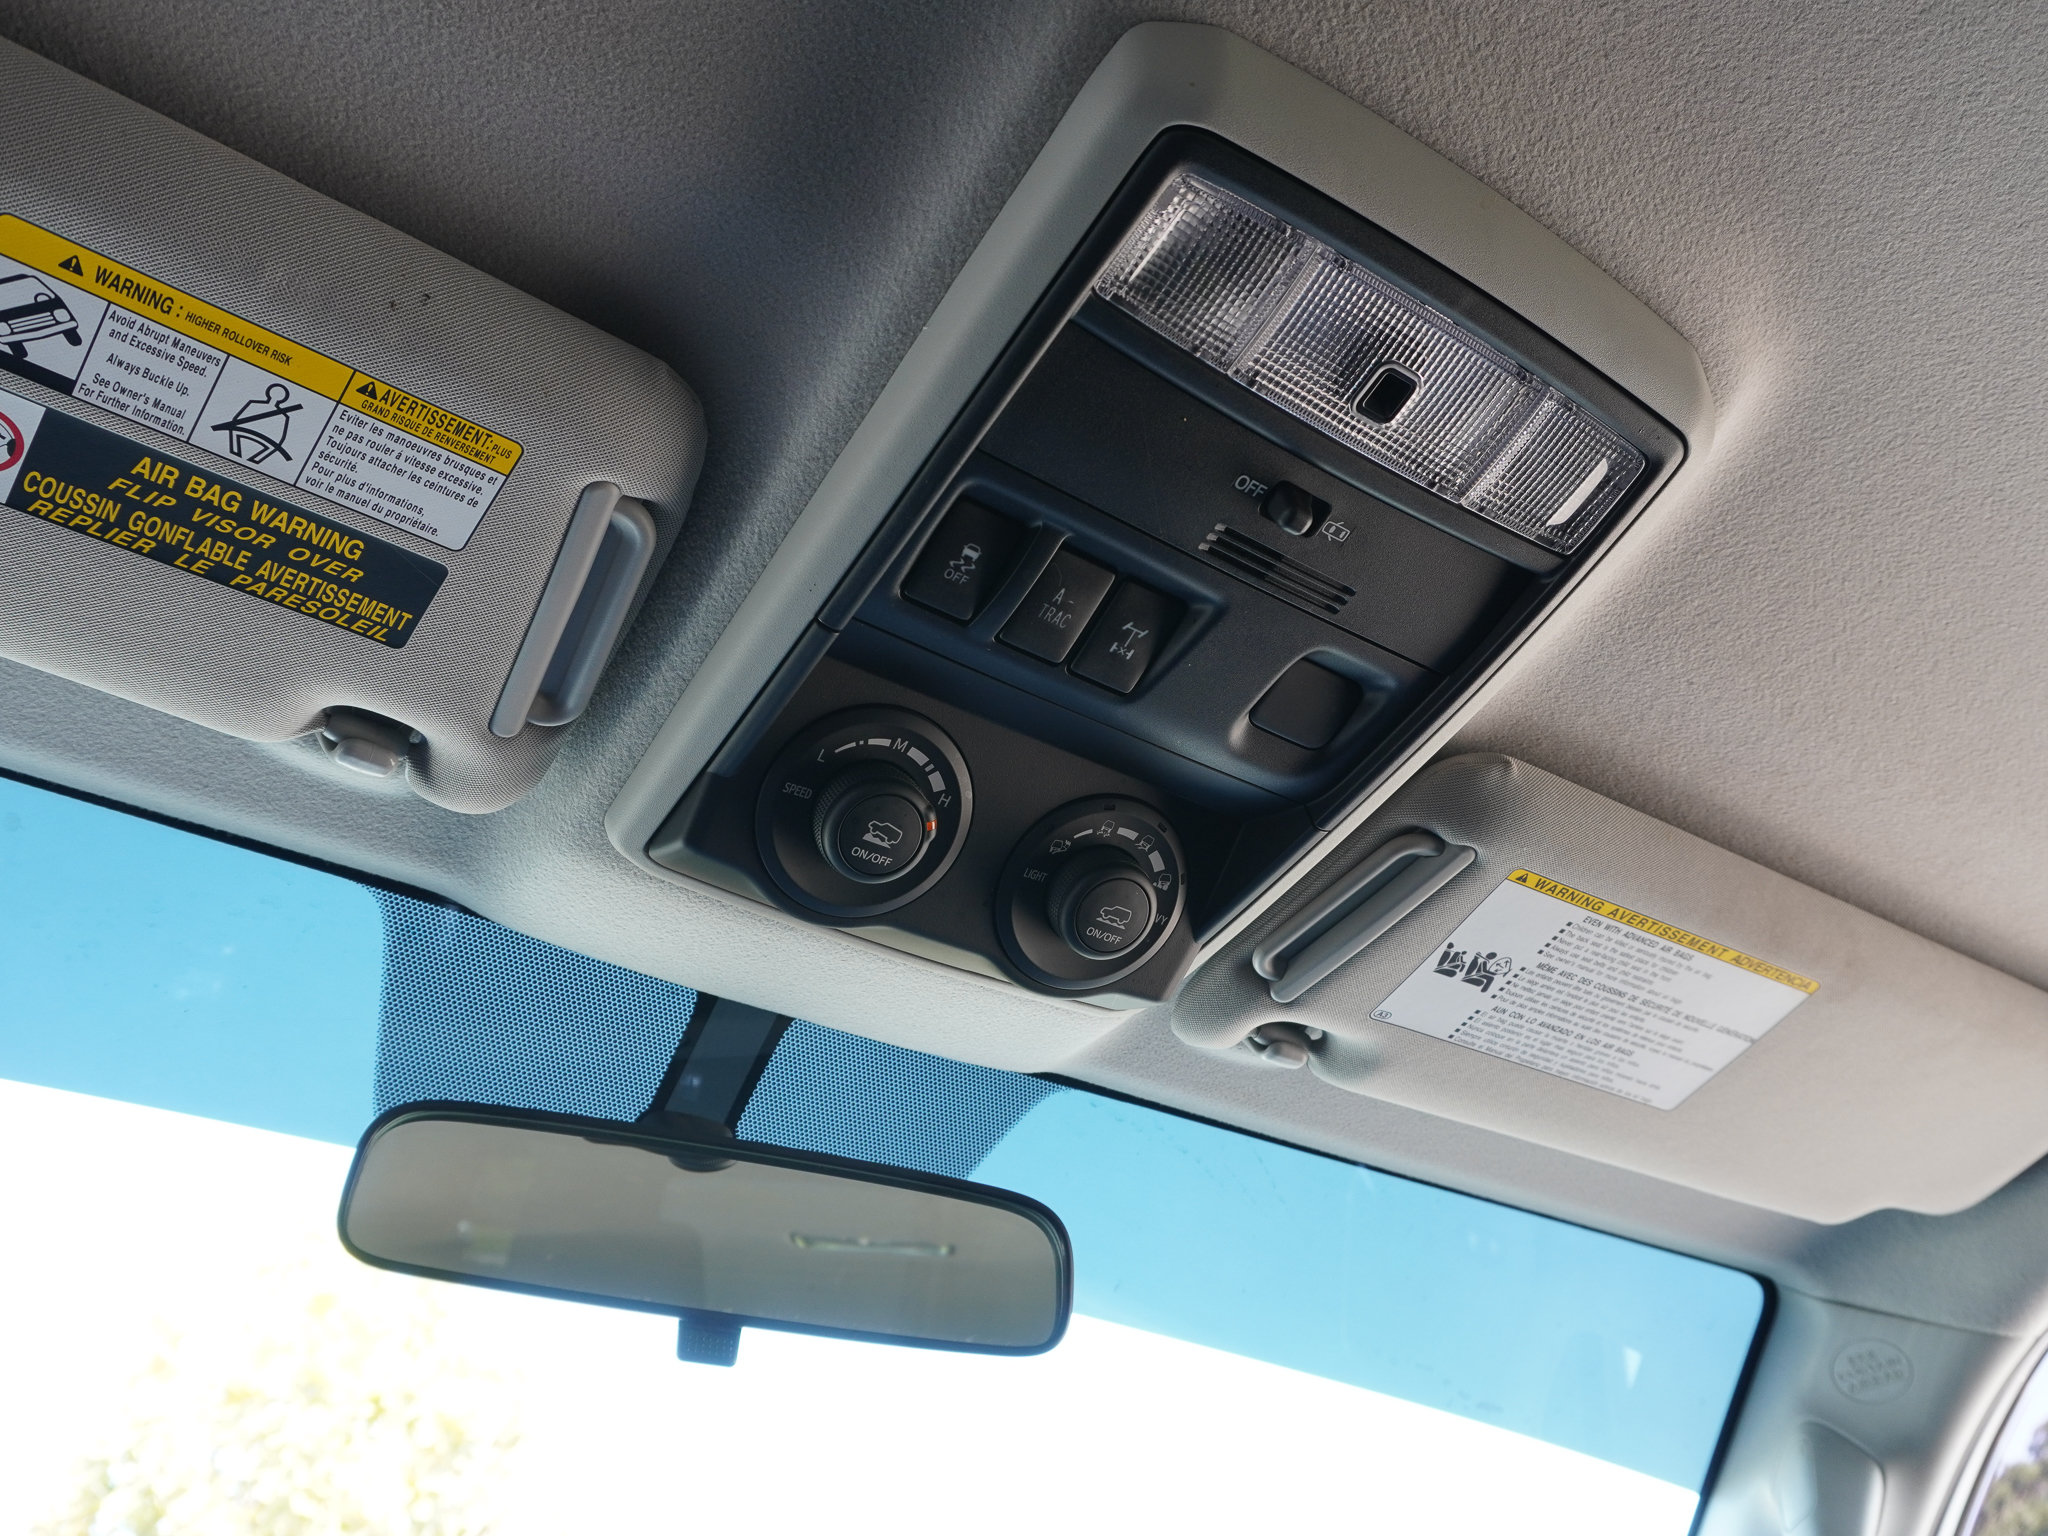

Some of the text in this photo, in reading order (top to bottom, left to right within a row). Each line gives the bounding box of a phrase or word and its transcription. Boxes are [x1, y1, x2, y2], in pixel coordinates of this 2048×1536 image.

[108, 310, 221, 367] Avoid Abrupt Maneuvers
[109, 328, 207, 378] and Excessive Speed.
[185, 311, 221, 334] HIGHER
[222, 328, 270, 356] ROLLOVER
[270, 349, 293, 366] RISK
[93, 373, 186, 420] See Owner's Manual
[106, 353, 189, 396] Always Buckle Up.
[78, 383, 185, 436] For Further Information.
[361, 400, 496, 465] GRAND RISQUE DE RENVERSEMENT
[379, 389, 513, 459] AVERTISSEMENT: PLUS
[318, 450, 358, 474] sécurité.
[332, 425, 344, 436] ne
[345, 432, 365, 446] pas
[367, 437, 395, 456] rouler
[404, 454, 436, 476] vitesse
[437, 470, 483, 496] excessive.
[339, 410, 498, 486] Eviter les manoeuvres brusques et
[311, 461, 425, 517] Pour plus d'informations,
[325, 436, 479, 509] Toujours attacher les ceintures de
[1235, 475, 1269, 496] OFF
[130, 456, 365, 561] AIR BAG WARNING
[305, 474, 439, 537] voir le manuel du propriétaire.
[23, 471, 413, 631] COUSSIN GONFLABLE AVERTISSEMENT
[107, 477, 364, 583] FLIP VISOR OVER
[27, 499, 388, 642] REPLIER LE PARESOLEIL
[944, 569, 970, 585] OFF
[1038, 603, 1072, 629] TRAC
[817, 749, 825, 763] L
[892, 738, 909, 753] M
[782, 782, 813, 800] SPEED
[937, 793, 952, 808] H
[851, 846, 893, 867] ON/OFF
[1023, 868, 1049, 883] LIGHT
[1086, 926, 1123, 945] ON/OFF
[1534, 878, 1812, 990] WARNING AVERTISSEMENT ADVERTENCIA
[1581, 915, 1604, 927] EVEN
[1602, 923, 1623, 934] WITH
[1620, 930, 1661, 948] ADVANCED
[1658, 944, 1674, 953] AIR
[1557, 969, 1578, 980] AVEC
[1576, 976, 1594, 985] DES
[1591, 982, 1629, 998] COUSSINS
[1490, 1005, 1508, 1014] AUN
[1507, 1011, 1526, 1020] CON
[1524, 1016, 1538, 1024] LO
[1536, 1020, 1574, 1036] AVANZADO
